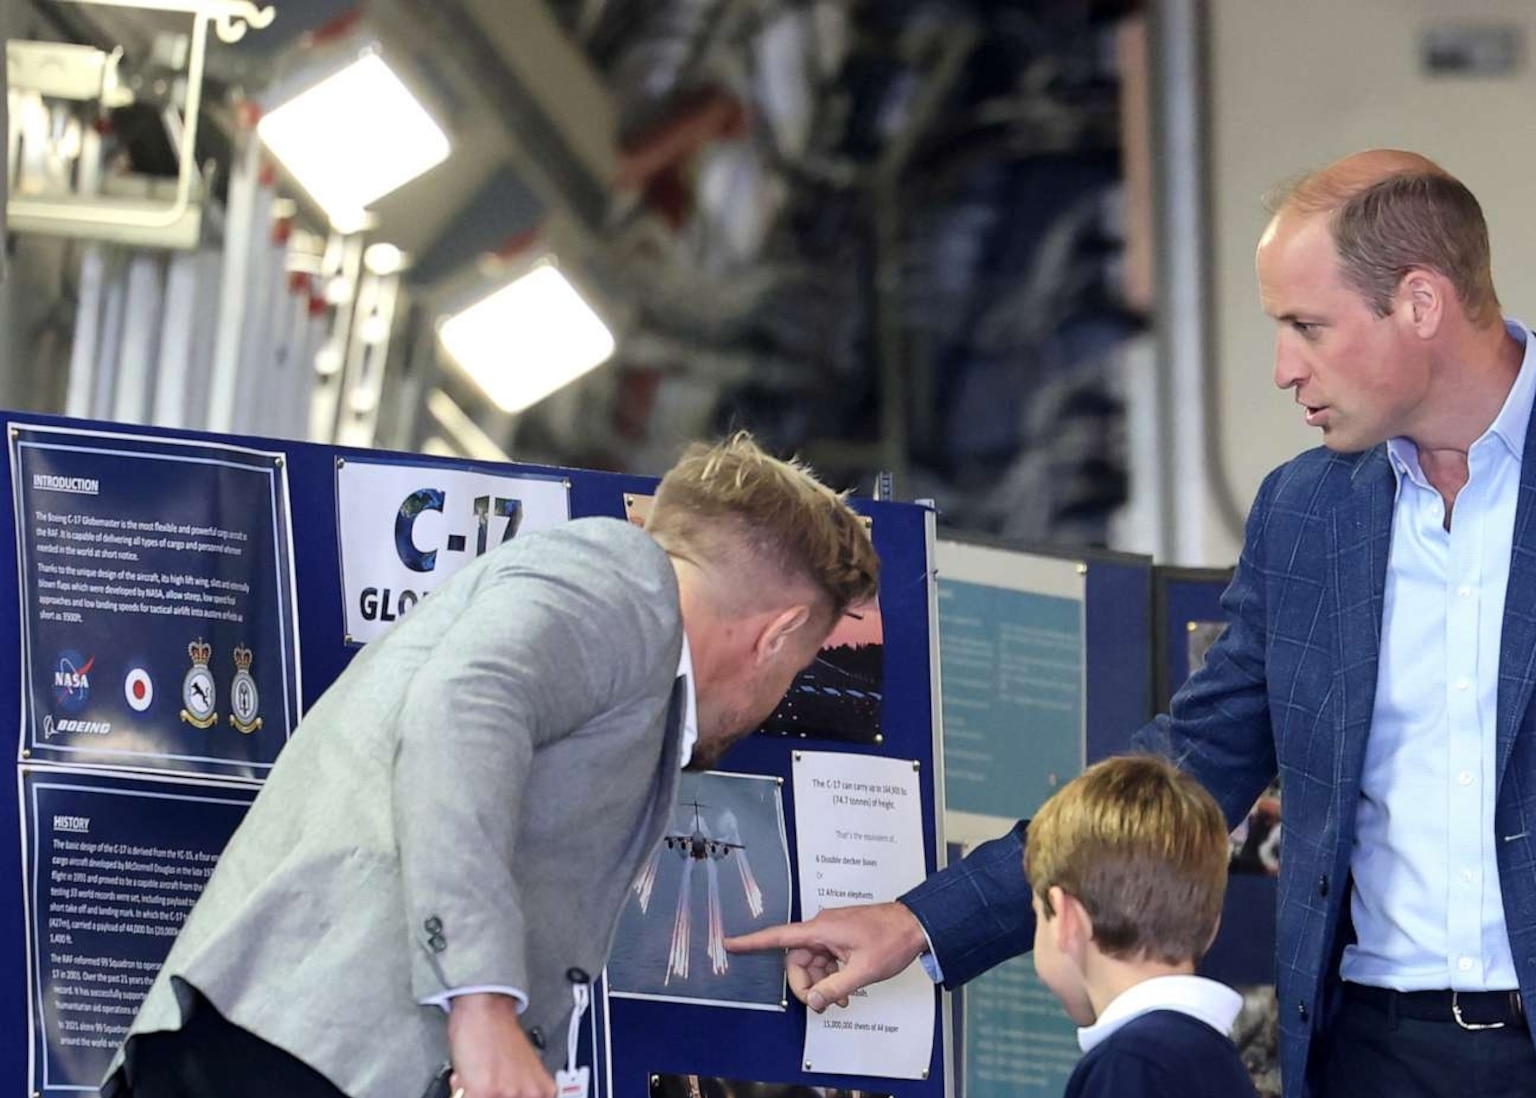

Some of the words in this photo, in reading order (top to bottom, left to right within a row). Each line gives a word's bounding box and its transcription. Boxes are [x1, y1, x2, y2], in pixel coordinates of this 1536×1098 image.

[33, 474, 99, 491] INTRODUCTION
[67, 514, 81, 524] C-17
[178, 524, 190, 534] and
[394, 488, 523, 572] C-17
[185, 541, 197, 550] and
[97, 569, 116, 581] design
[117, 570, 124, 579] of
[125, 571, 136, 581] the
[170, 574, 184, 586] high
[105, 585, 137, 597] developed
[359, 586, 431, 622] GLO
[54, 671, 89, 688] NASA
[57, 719, 112, 734] BOEING
[812, 778, 825, 788] The
[826, 779, 841, 789] C-17
[842, 782, 852, 790] can
[53, 815, 90, 829] HISTORY
[53, 839, 64, 849] The
[114, 844, 127, 855] C-17
[821, 855, 841, 865] Double
[826, 888, 846, 897] African
[847, 890, 873, 900] elephants
